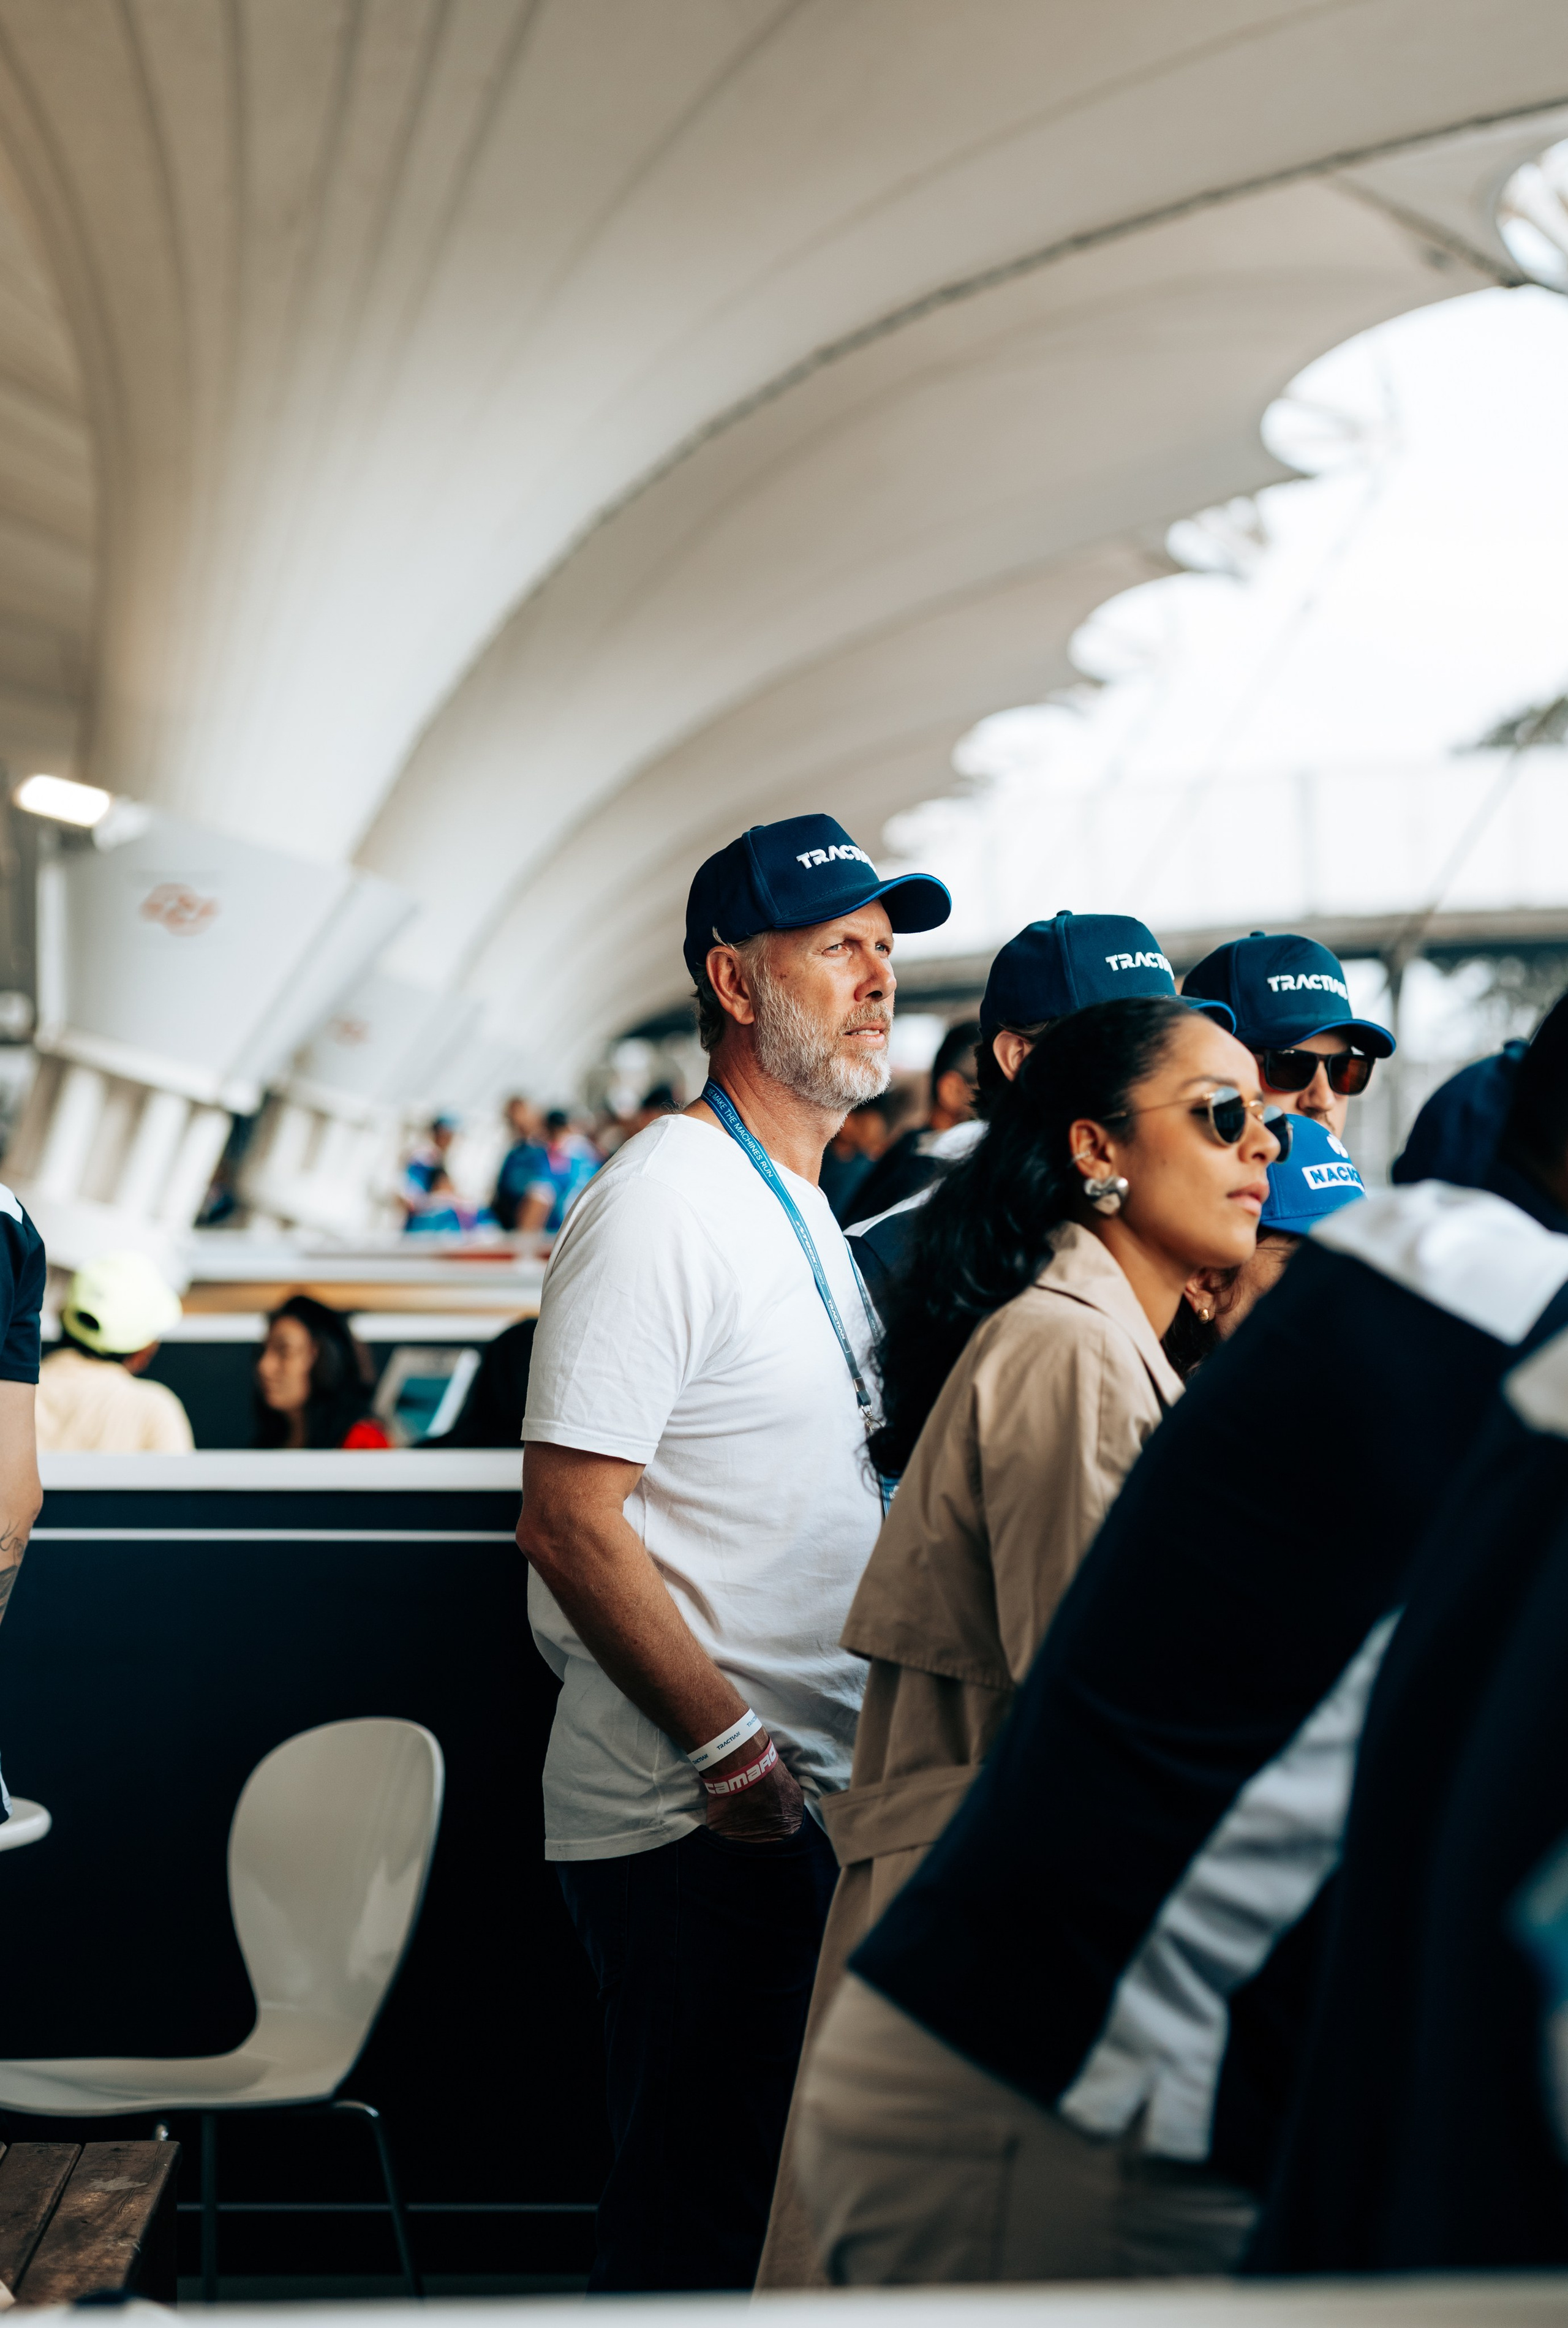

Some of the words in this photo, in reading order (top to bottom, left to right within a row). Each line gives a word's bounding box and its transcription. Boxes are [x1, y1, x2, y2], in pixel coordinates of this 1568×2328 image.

[707, 1087, 715, 1097] WE
[712, 1093, 726, 1110] MAKE
[725, 1109, 736, 1123] THE
[734, 1123, 763, 1161] MACHINES
[761, 1161, 773, 1178] RUN
[1310, 1166, 1364, 1185] NACIO
[827, 1298, 846, 1339] TRACTIAN
[716, 1731, 741, 1750] TRACTIAN
